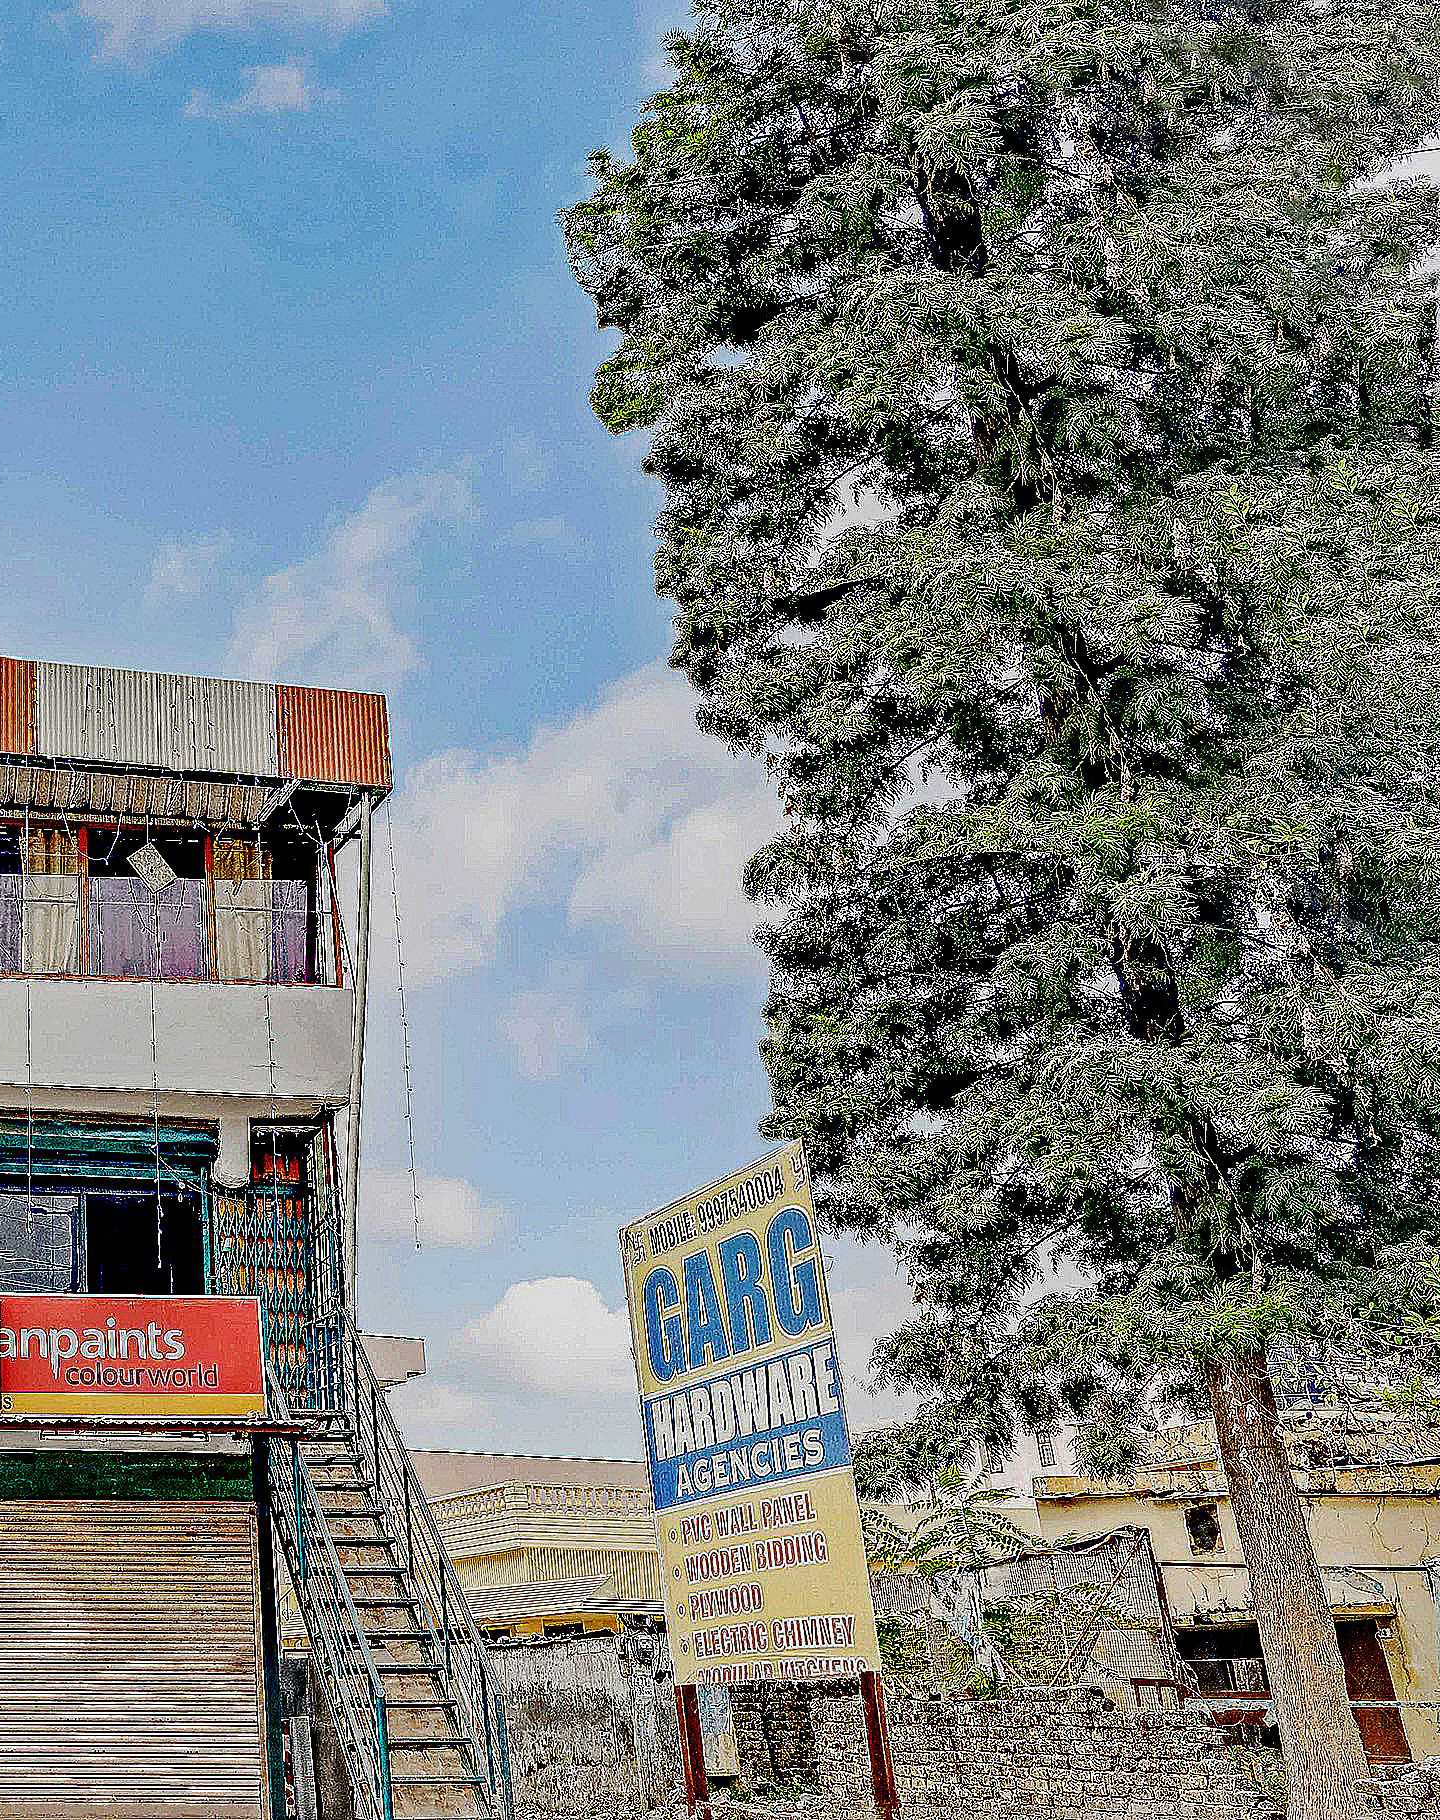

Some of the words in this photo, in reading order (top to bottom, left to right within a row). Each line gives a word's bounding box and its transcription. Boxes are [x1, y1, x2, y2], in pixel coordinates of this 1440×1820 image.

[648, 1210, 697, 1256] MOBILE:
[697, 1164, 784, 1231] 9997540004
[643, 1208, 825, 1384] GARG
[651, 1344, 840, 1461] HARDWARE
[676, 1427, 826, 1500] AGENCIES
[681, 1513, 712, 1546] PVC
[716, 1503, 759, 1538] WALL
[761, 1492, 817, 1529] PANEL
[685, 1545, 753, 1583] WOODEN
[755, 1531, 828, 1570] BIDDING
[690, 1583, 763, 1622] PLYWOOD
[694, 1622, 768, 1659] ELECTRIC
[771, 1615, 854, 1650] CHIMNEY
